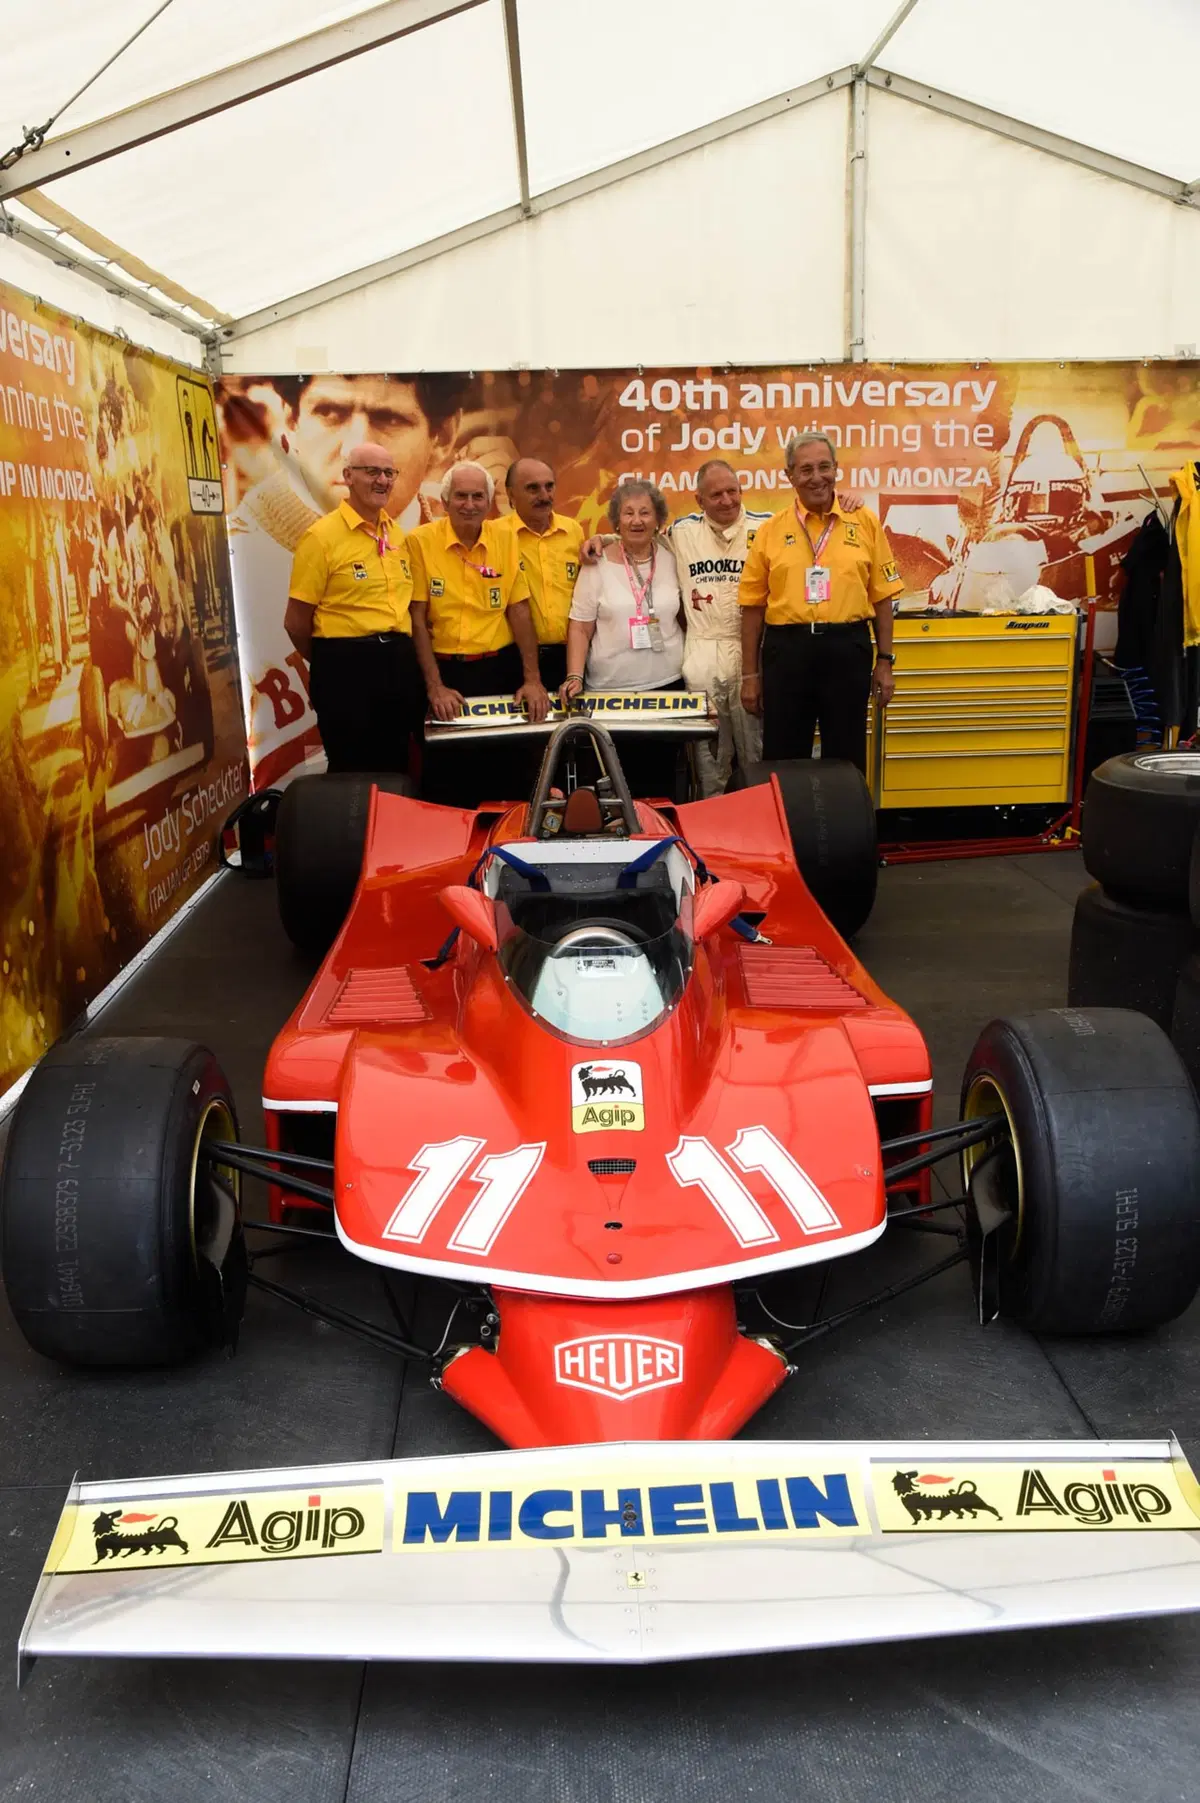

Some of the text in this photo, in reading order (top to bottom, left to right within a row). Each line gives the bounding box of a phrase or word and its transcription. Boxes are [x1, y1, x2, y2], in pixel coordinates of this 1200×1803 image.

[618, 375, 997, 413] 40th anniversary
[54, 393, 87, 441] the
[621, 423, 660, 453] of
[671, 421, 766, 454] Jody
[932, 419, 994, 448] the
[19, 463, 38, 499] IN
[40, 466, 96, 502] MONZA
[851, 467, 886, 488] IN
[890, 467, 993, 488] MONZA
[695, 574, 727, 584] CHEWING
[577, 697, 699, 711] MICHELIN
[143, 762, 244, 871] Jody Scheckter
[149, 868, 181, 915] ITALIAN
[582, 1104, 636, 1128] Agip
[382, 1134, 547, 1256] 11
[665, 1124, 843, 1248] 11
[565, 1339, 675, 1391] HEUER
[205, 1468, 1173, 1554] Agip MICHELIN Agip
